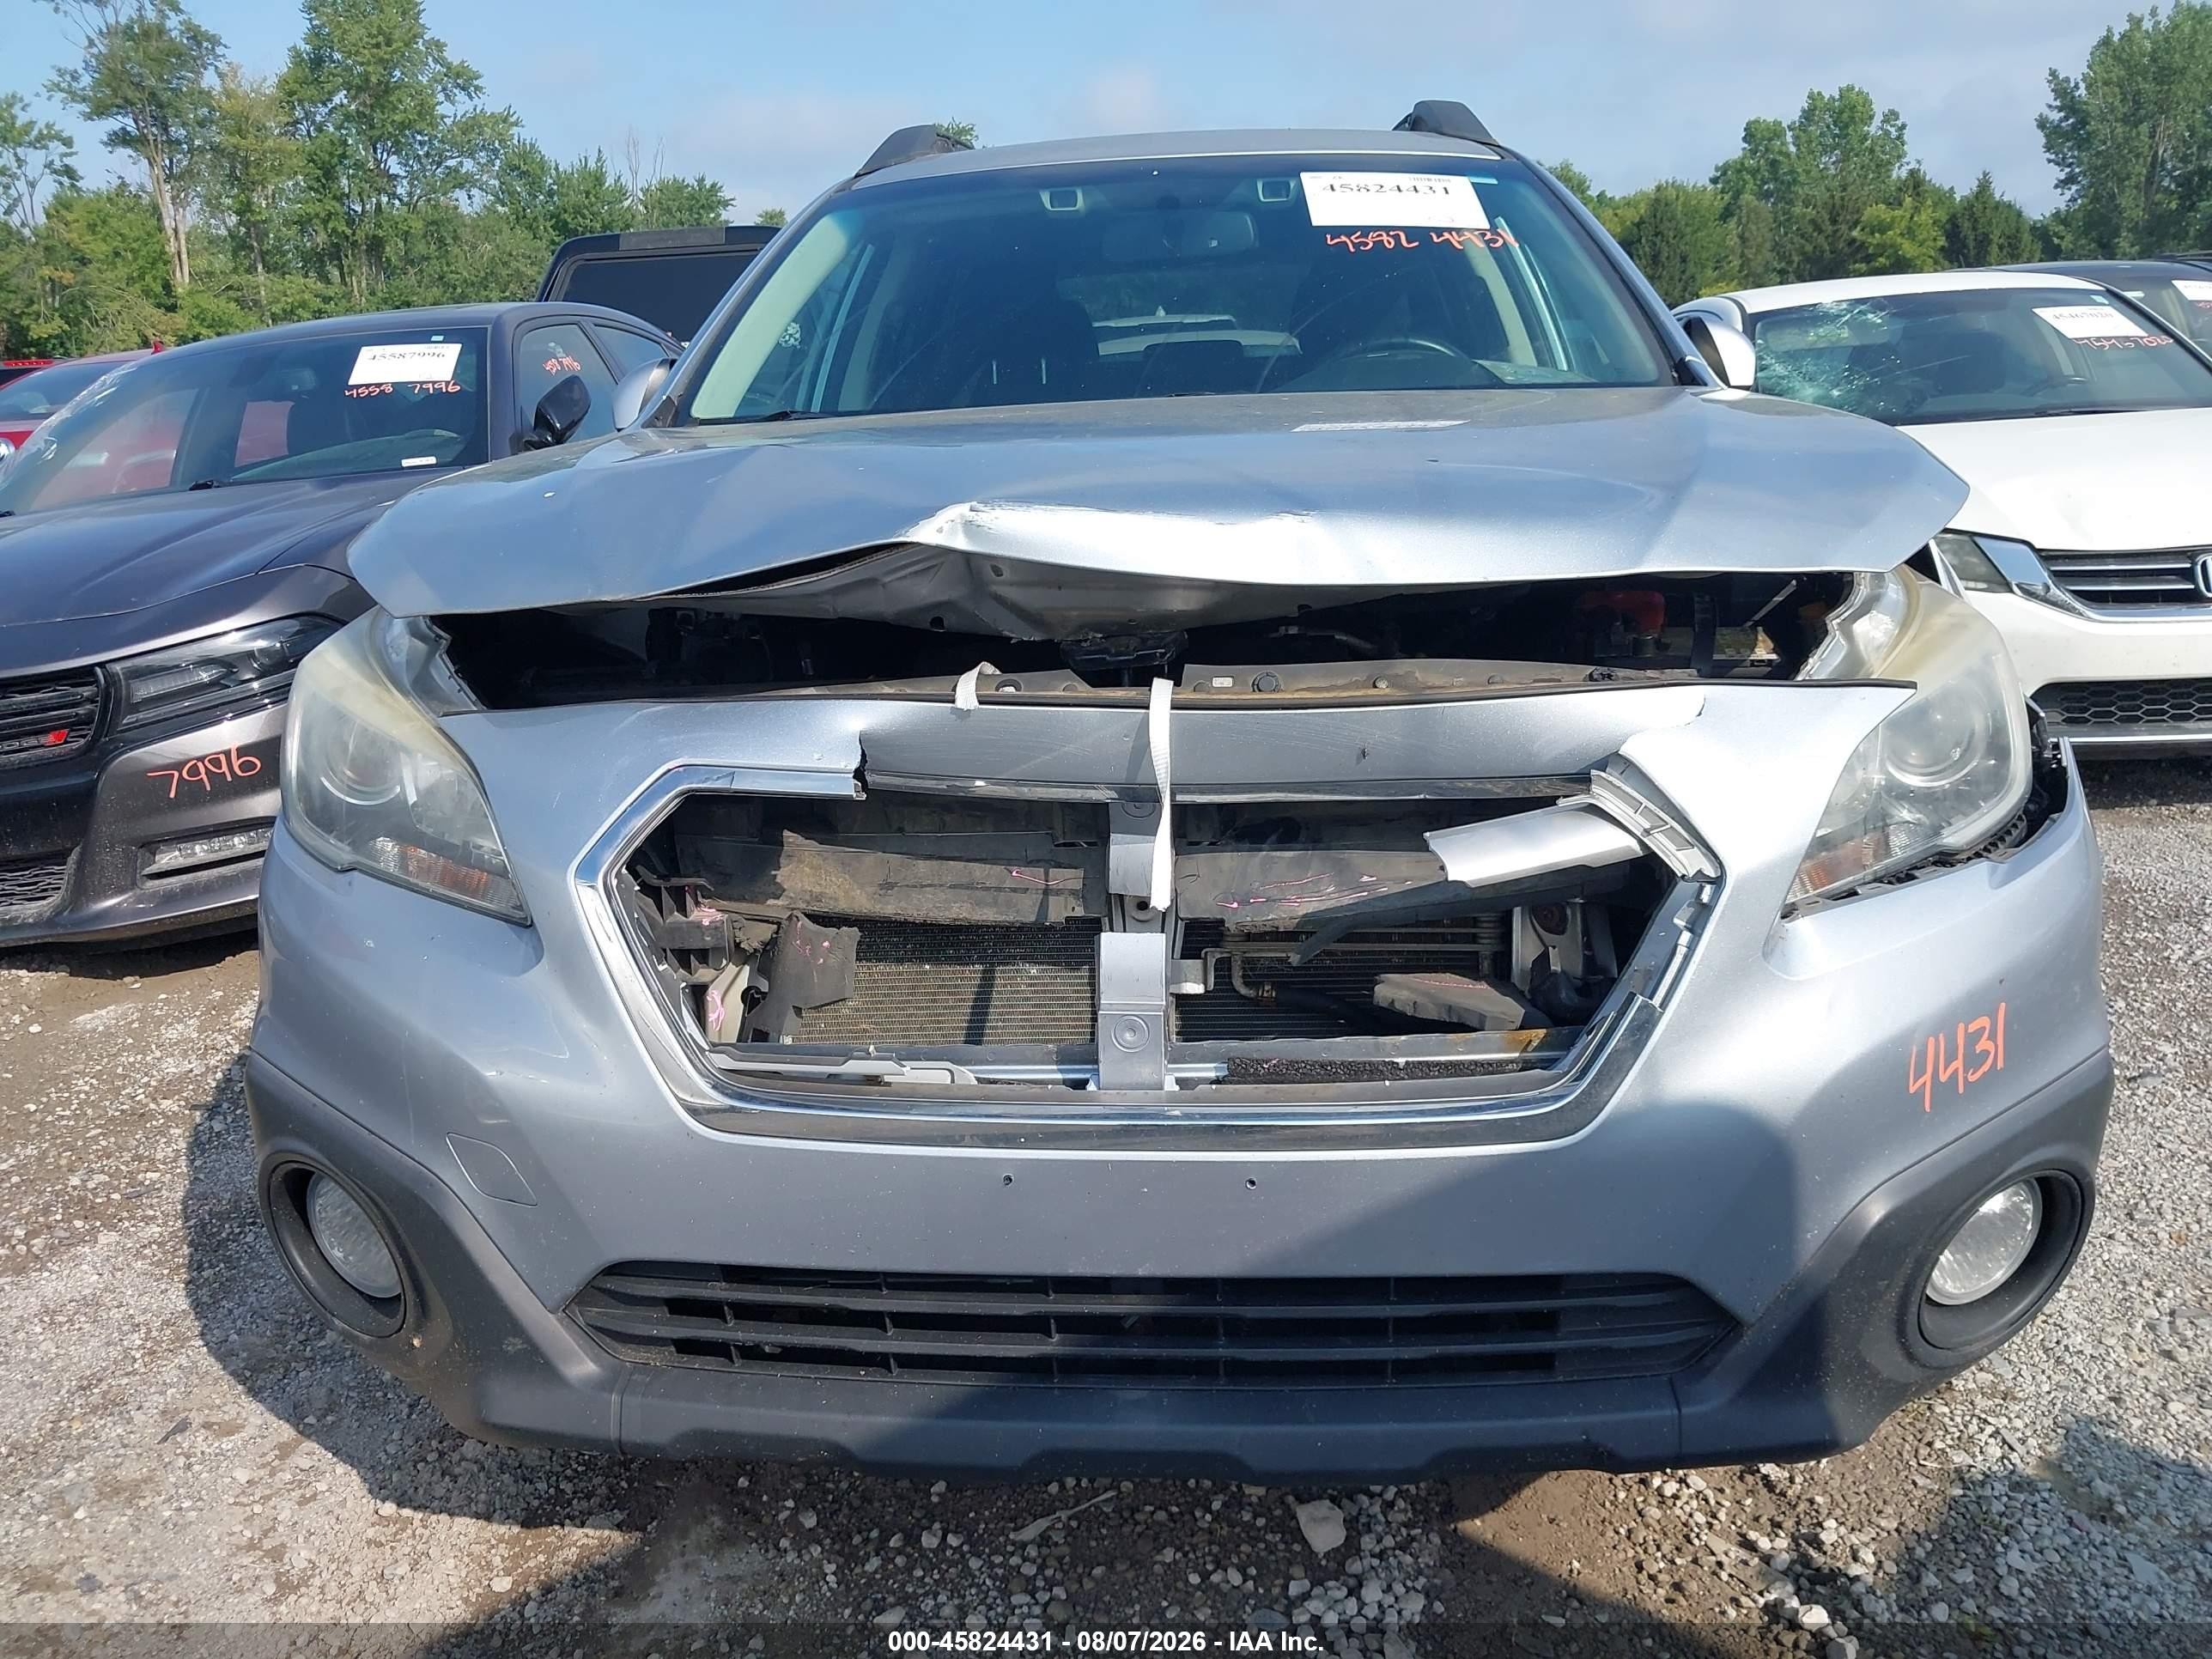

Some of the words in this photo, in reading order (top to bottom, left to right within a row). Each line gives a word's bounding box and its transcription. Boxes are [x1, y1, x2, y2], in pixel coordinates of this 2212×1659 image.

[1322, 183, 1450, 196] 45824431
[1429, 228, 1520, 250] 4431
[368, 351, 446, 361] 45587996
[344, 383, 393, 398] 4558
[407, 380, 461, 394] 7996
[146, 743, 262, 799] 7996
[1909, 1002, 2006, 1113] 4431
